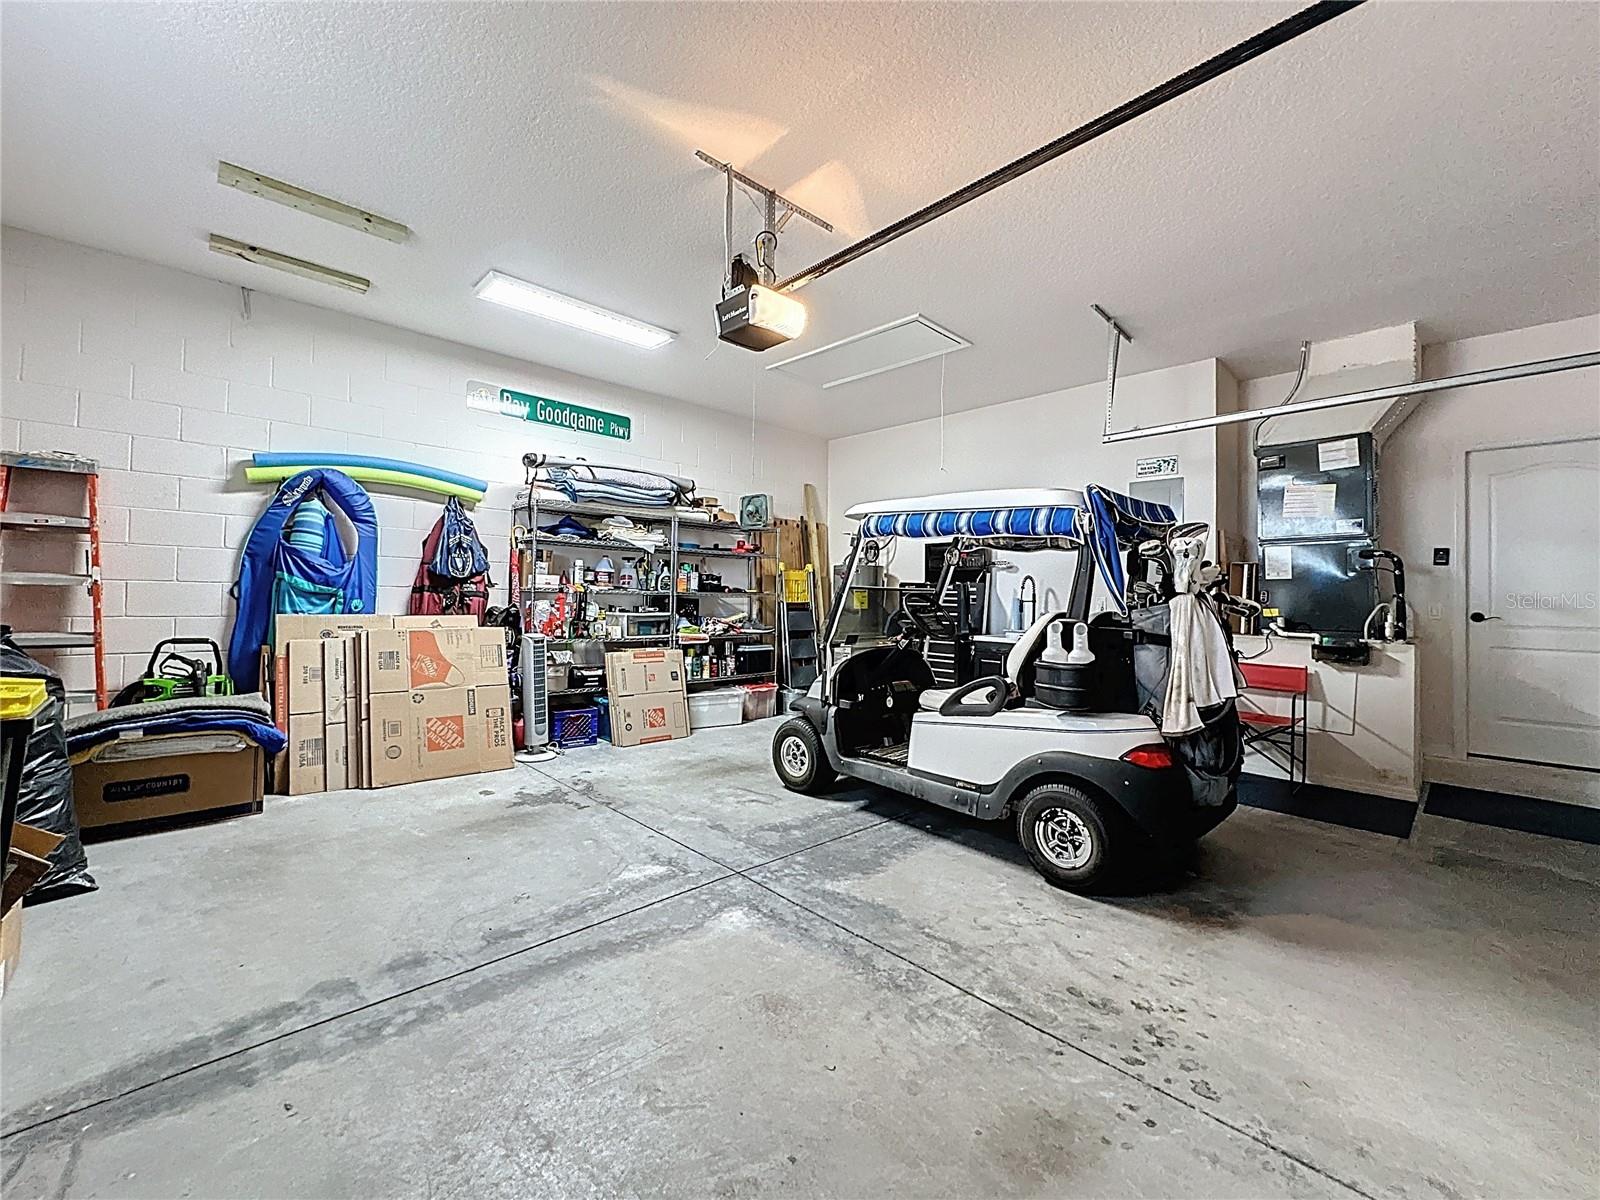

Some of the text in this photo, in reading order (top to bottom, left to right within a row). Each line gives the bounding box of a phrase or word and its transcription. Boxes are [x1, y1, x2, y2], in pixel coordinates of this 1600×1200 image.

[503, 392, 530, 420] Ray
[537, 400, 604, 432] Goodgame
[610, 422, 629, 439] Pkwy
[427, 717, 464, 748] HOME
[446, 720, 458, 731] THE
[427, 731, 450, 750] DEPOT
[298, 753, 306, 768] USA
